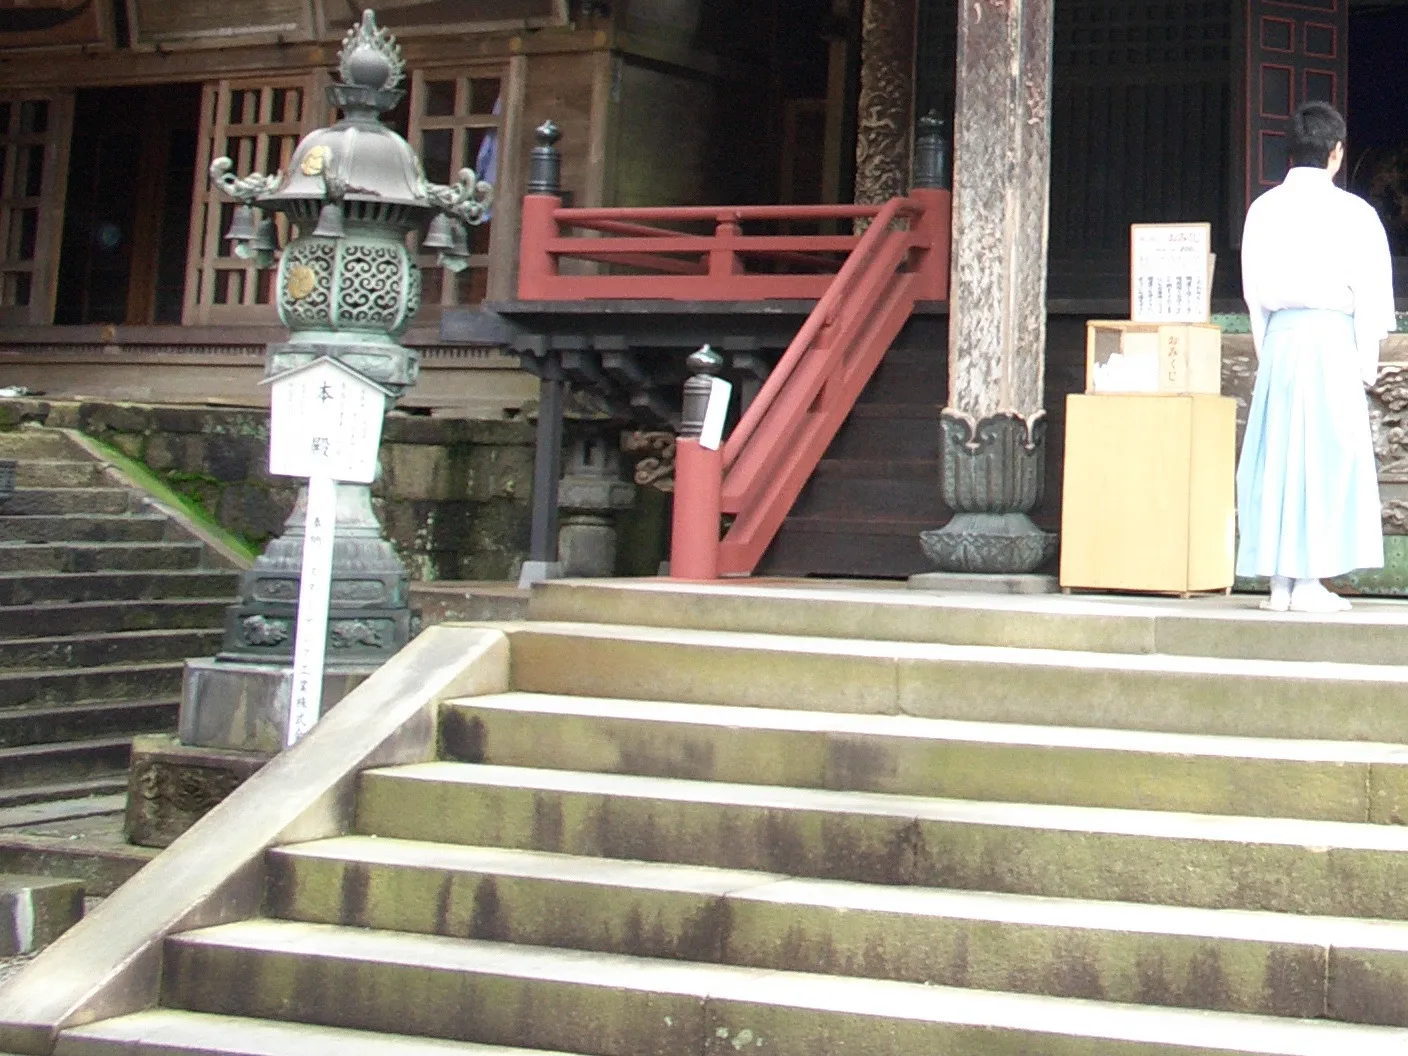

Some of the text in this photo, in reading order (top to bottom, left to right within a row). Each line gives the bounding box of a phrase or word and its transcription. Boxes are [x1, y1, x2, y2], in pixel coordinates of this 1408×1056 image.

[1168, 335, 1180, 382] おみくじ
[310, 381, 334, 458] 本殿
